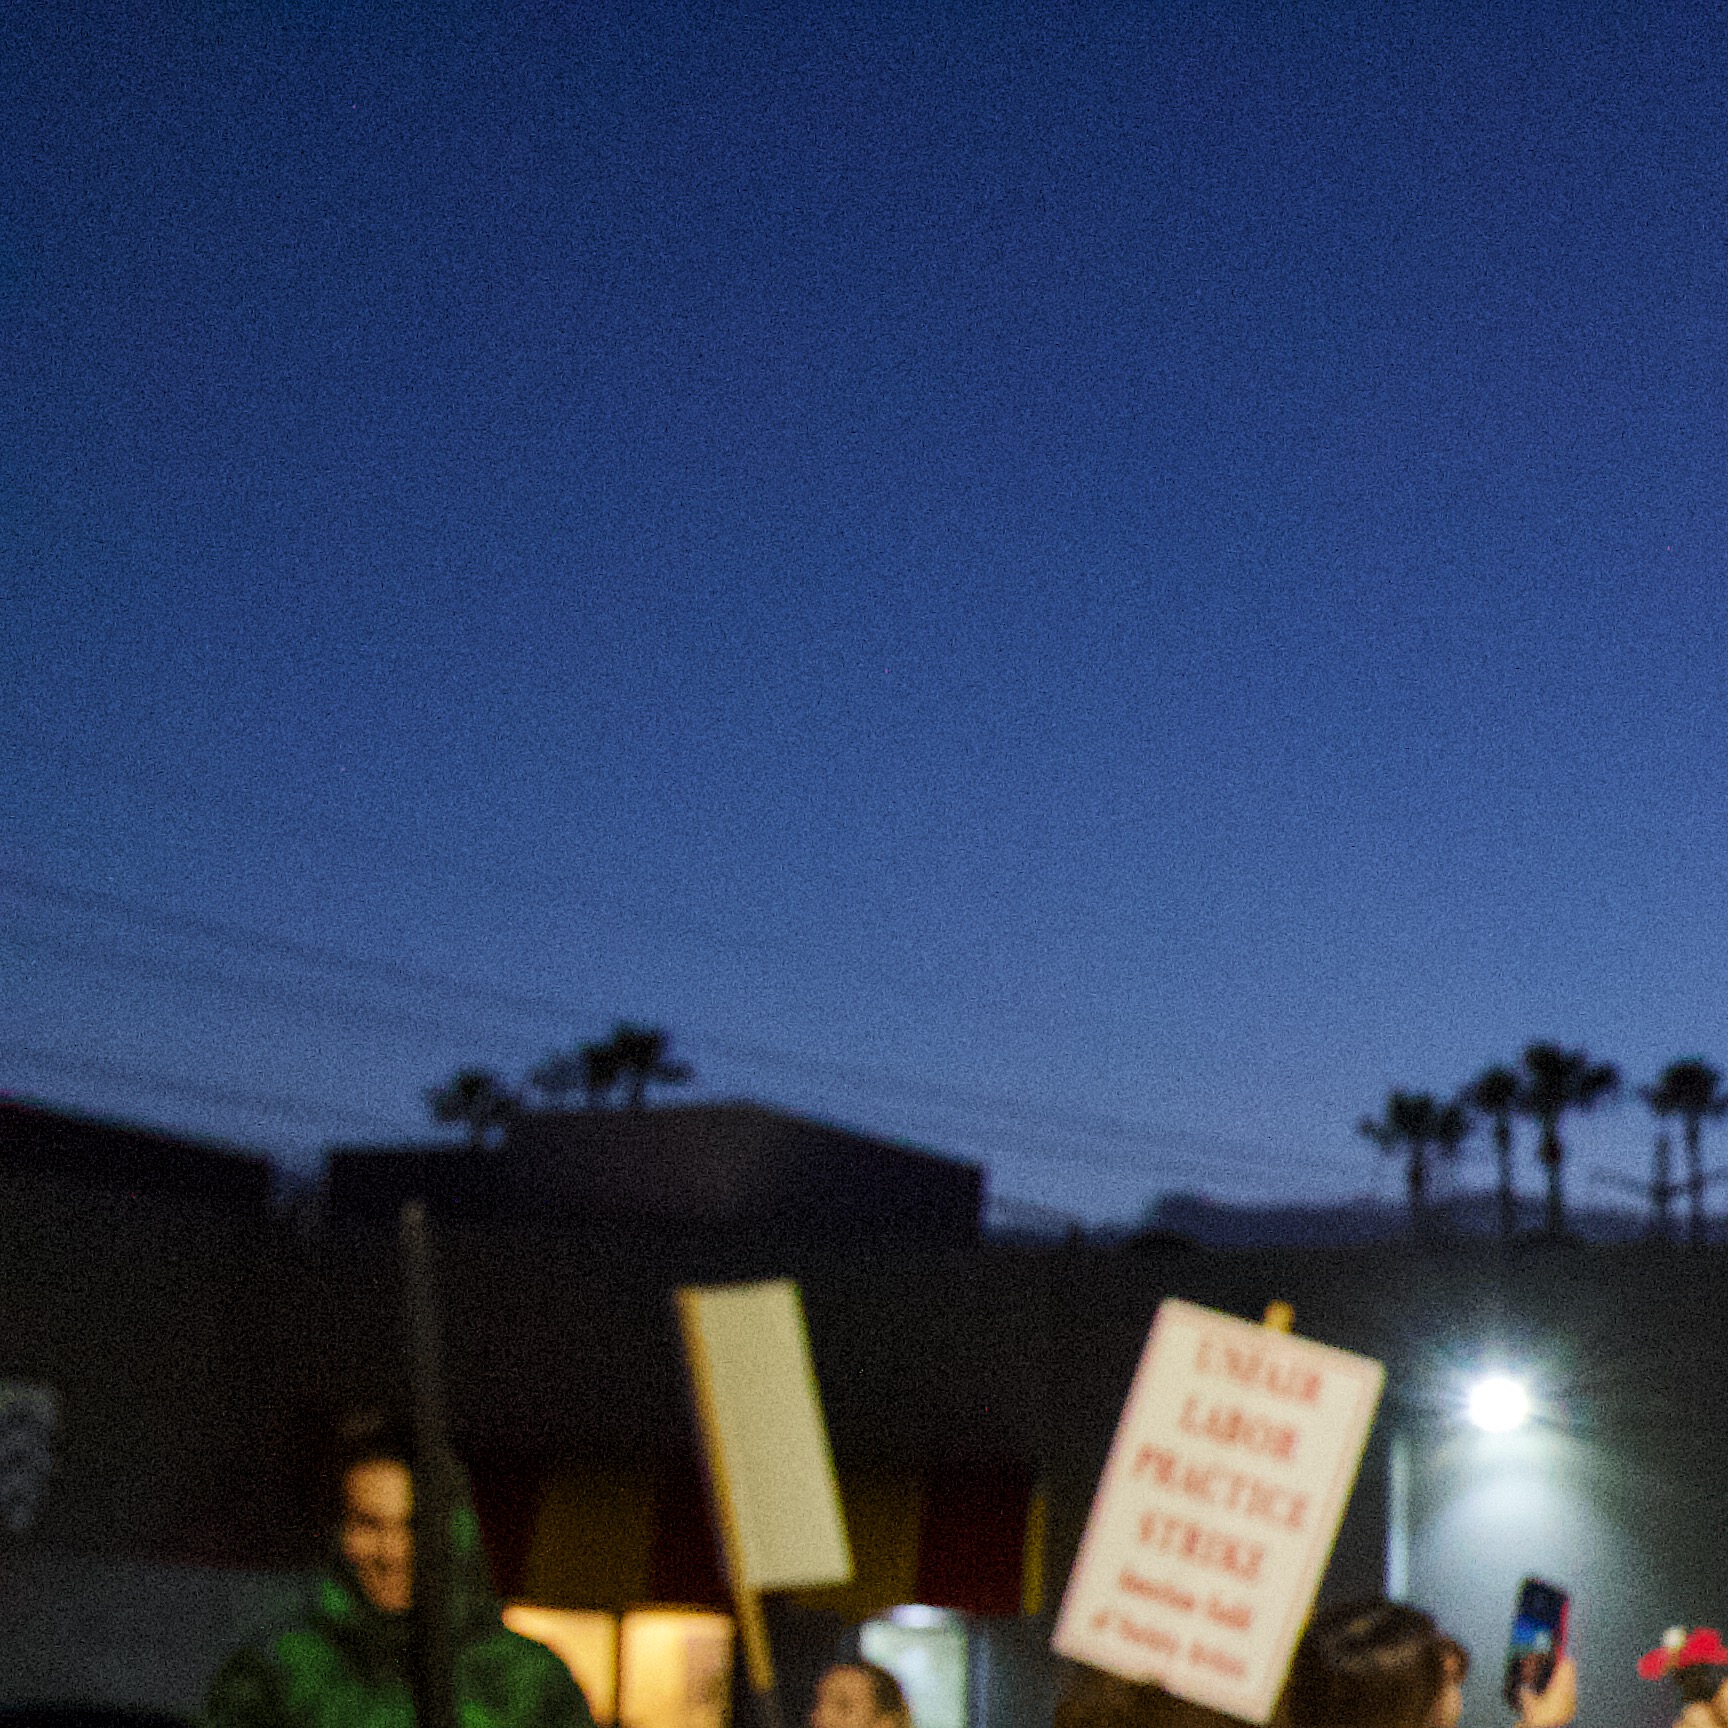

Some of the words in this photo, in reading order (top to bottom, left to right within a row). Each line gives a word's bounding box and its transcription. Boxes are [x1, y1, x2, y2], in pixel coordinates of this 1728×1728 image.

[1193, 1337, 1325, 1404] UNFAIR
[1178, 1396, 1300, 1464] LABOR
[1131, 1440, 1309, 1534] PRACTICE
[1138, 1509, 1267, 1583] STRIKE
